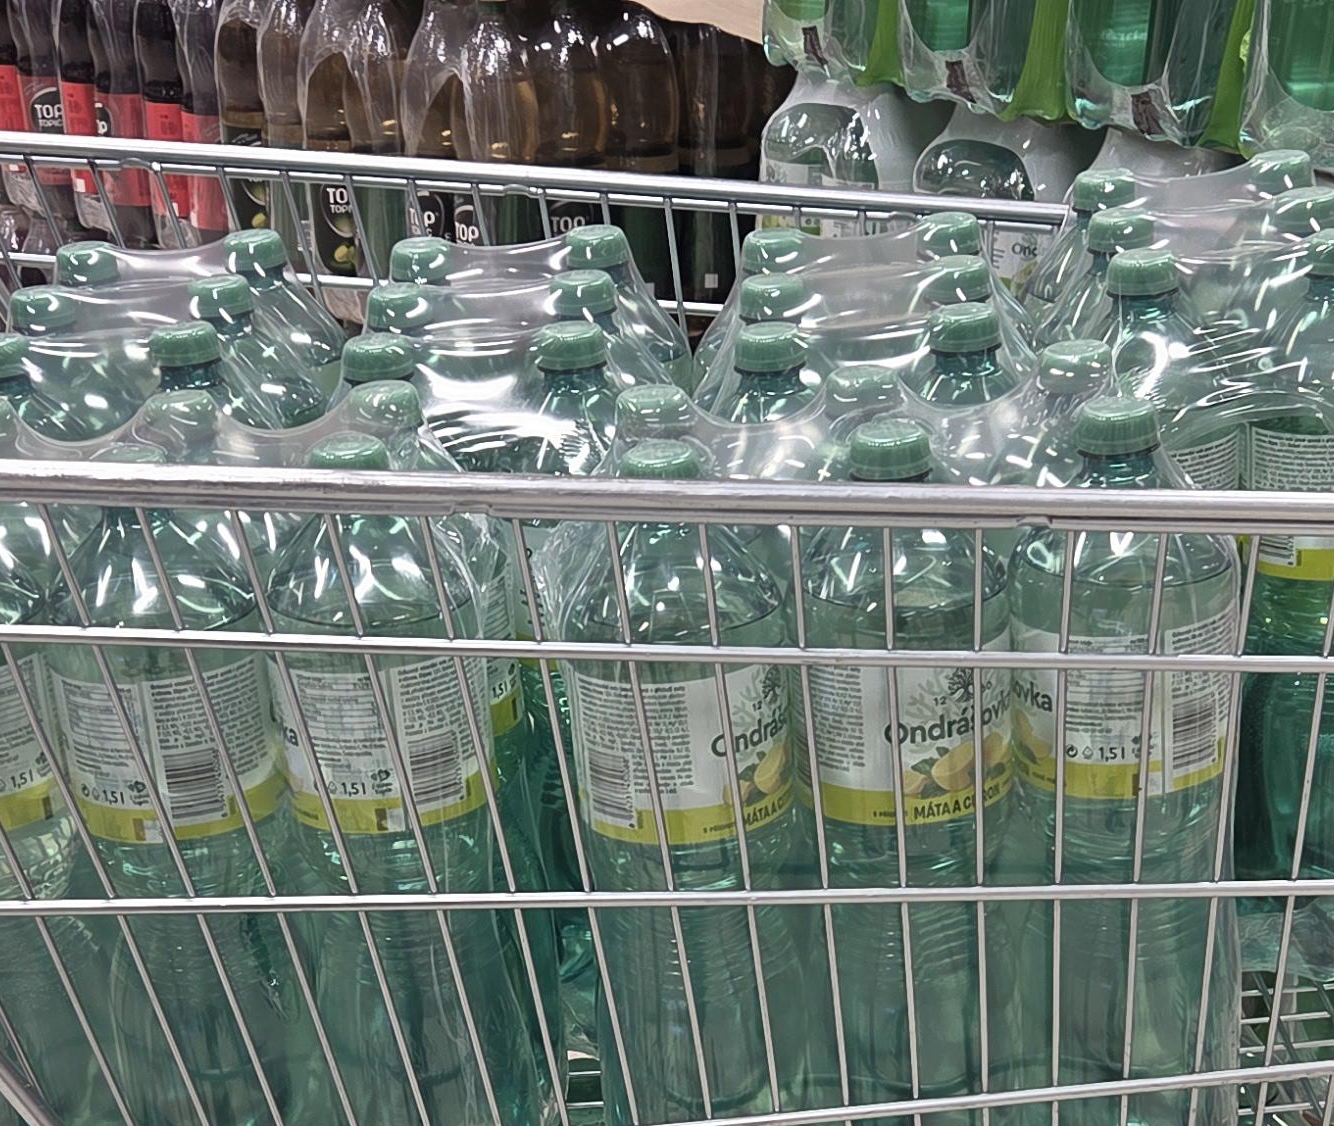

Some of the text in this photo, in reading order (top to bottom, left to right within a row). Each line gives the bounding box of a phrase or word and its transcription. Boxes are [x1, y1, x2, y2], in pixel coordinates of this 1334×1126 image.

[1098, 747, 1117, 763] 1,5
[10, 773, 28, 790] 1,5
[341, 782, 361, 798] 1,5
[914, 801, 951, 820] MÁTA
[952, 799, 962, 812] A
